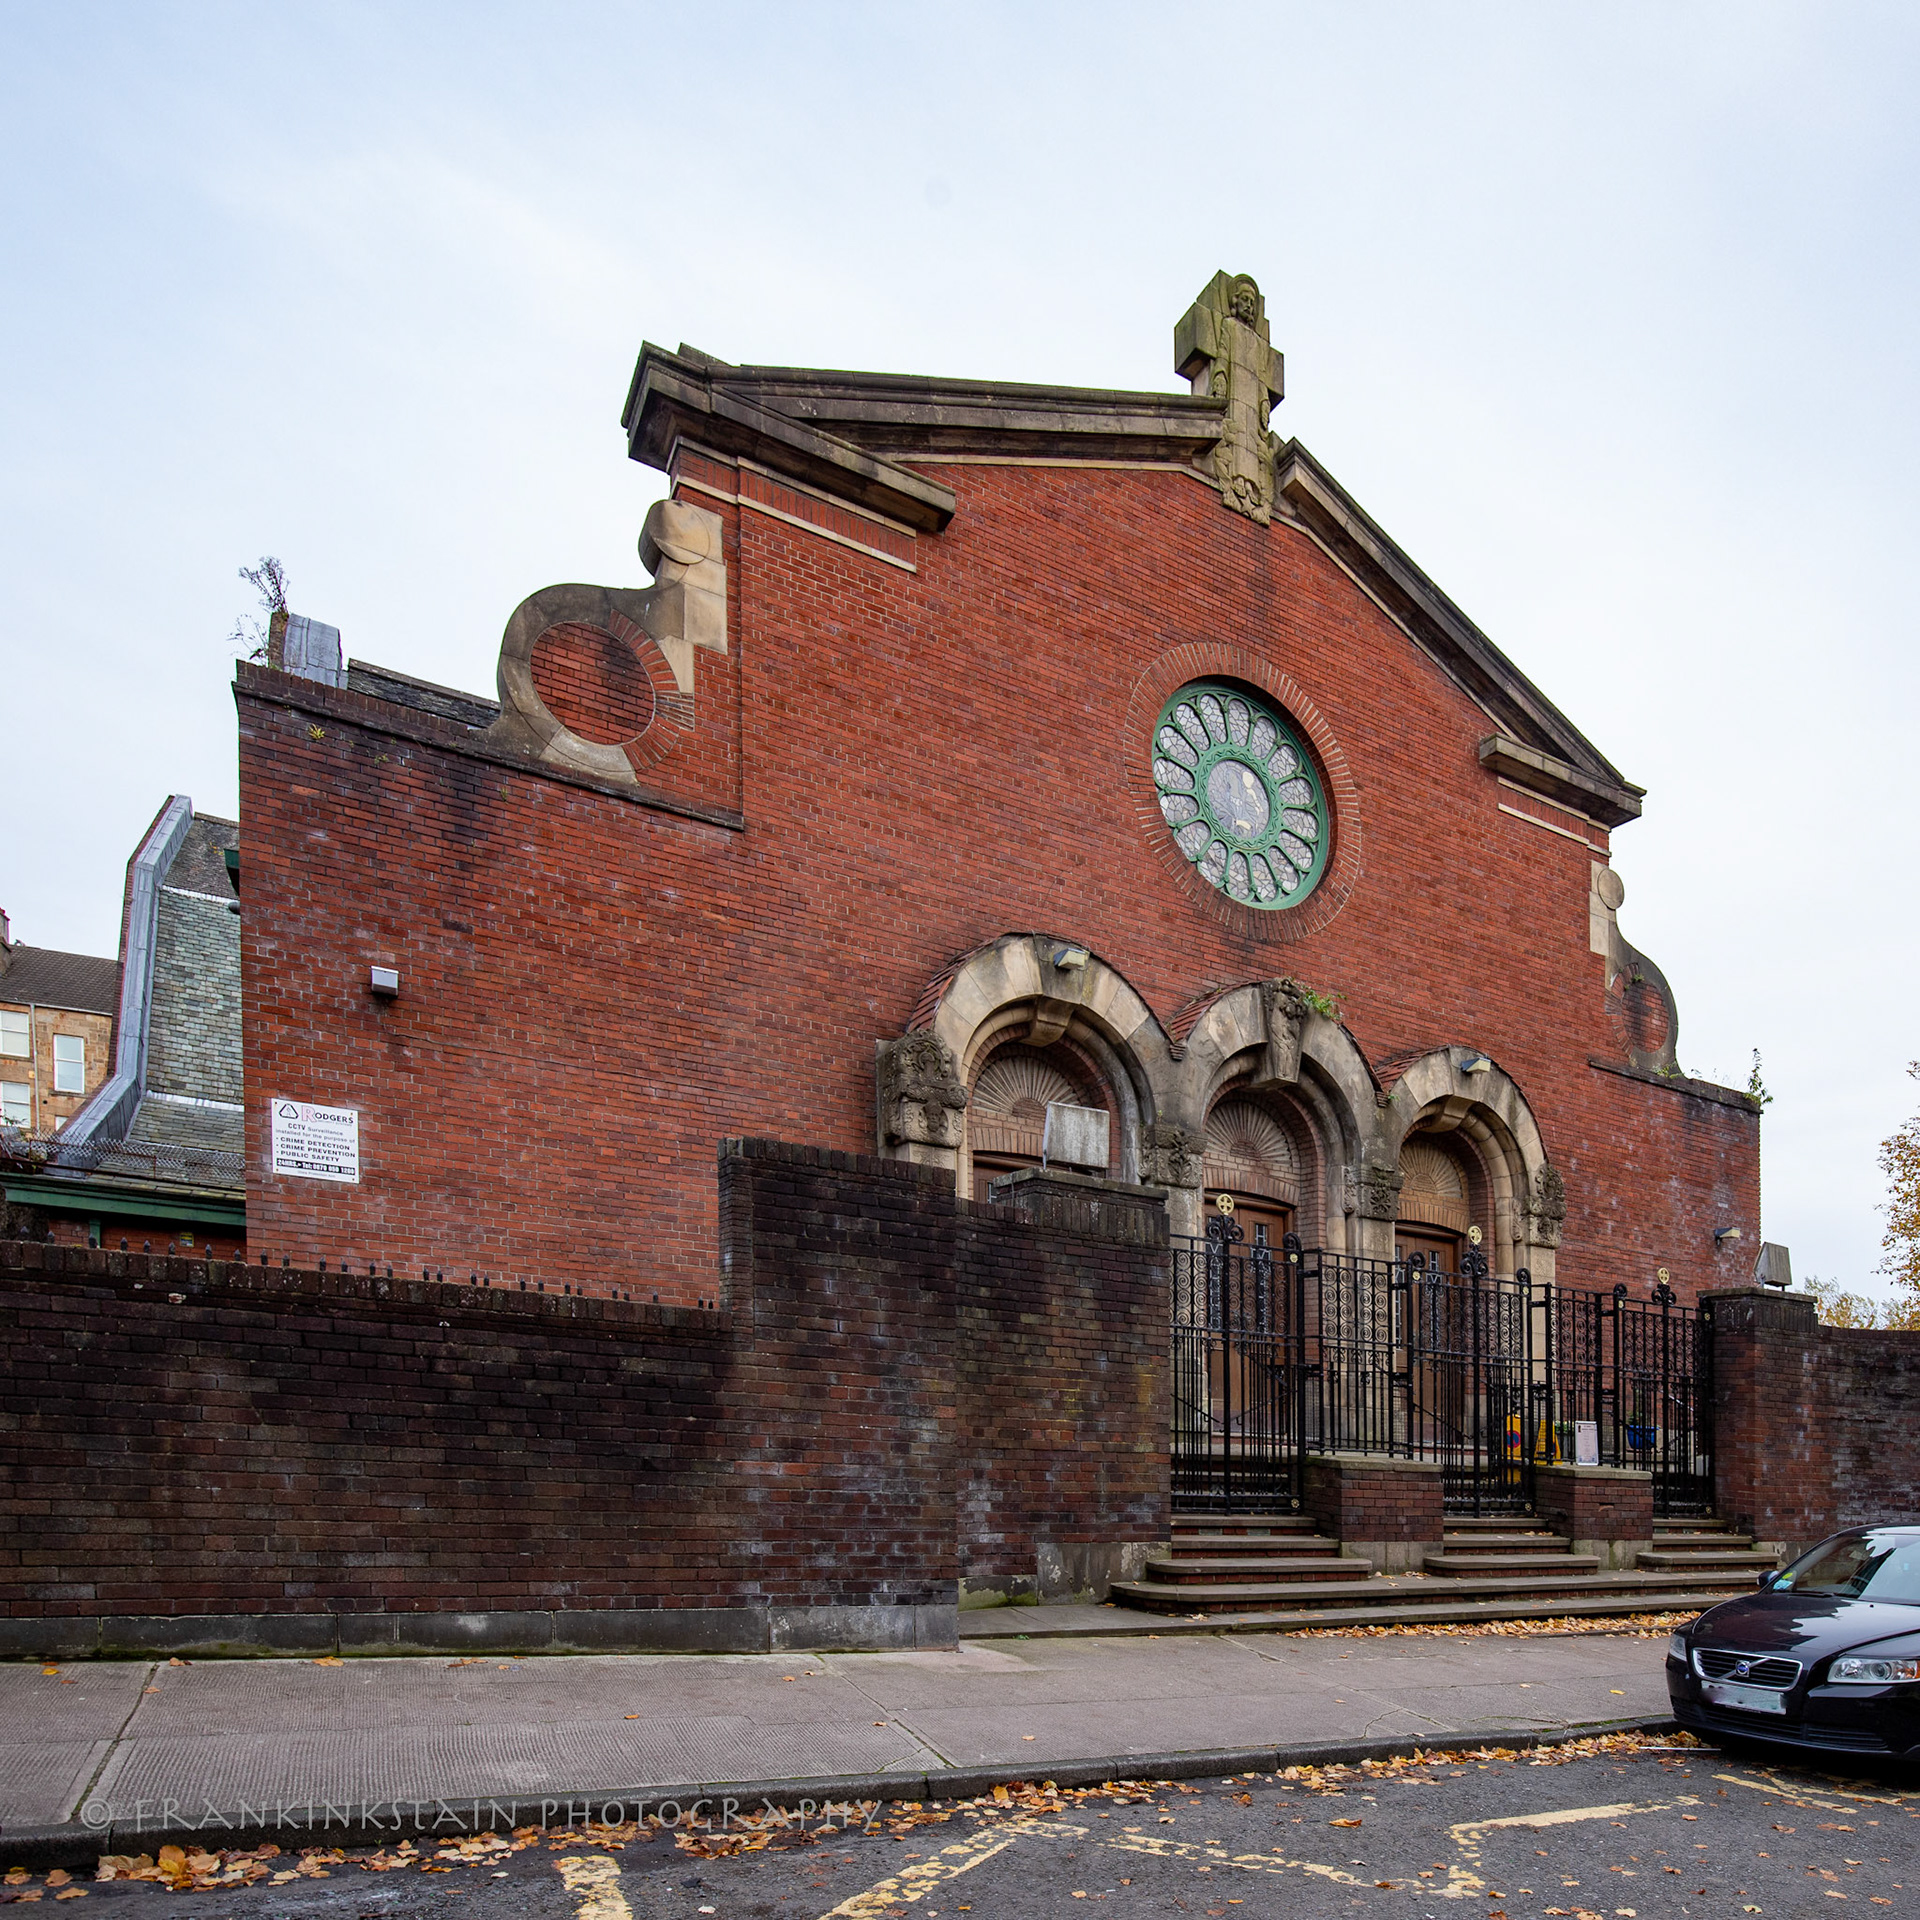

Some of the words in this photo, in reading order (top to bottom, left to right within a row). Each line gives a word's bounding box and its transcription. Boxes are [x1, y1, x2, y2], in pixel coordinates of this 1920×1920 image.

[302, 1105, 354, 1124] RODGERS
[308, 1127, 343, 1136] Surveillance
[308, 1140, 350, 1150] DETECTION
[281, 1150, 309, 1158] PUBLIC
[312, 1154, 340, 1162] SAFETY
[308, 1147, 355, 1157] PREVENTION
